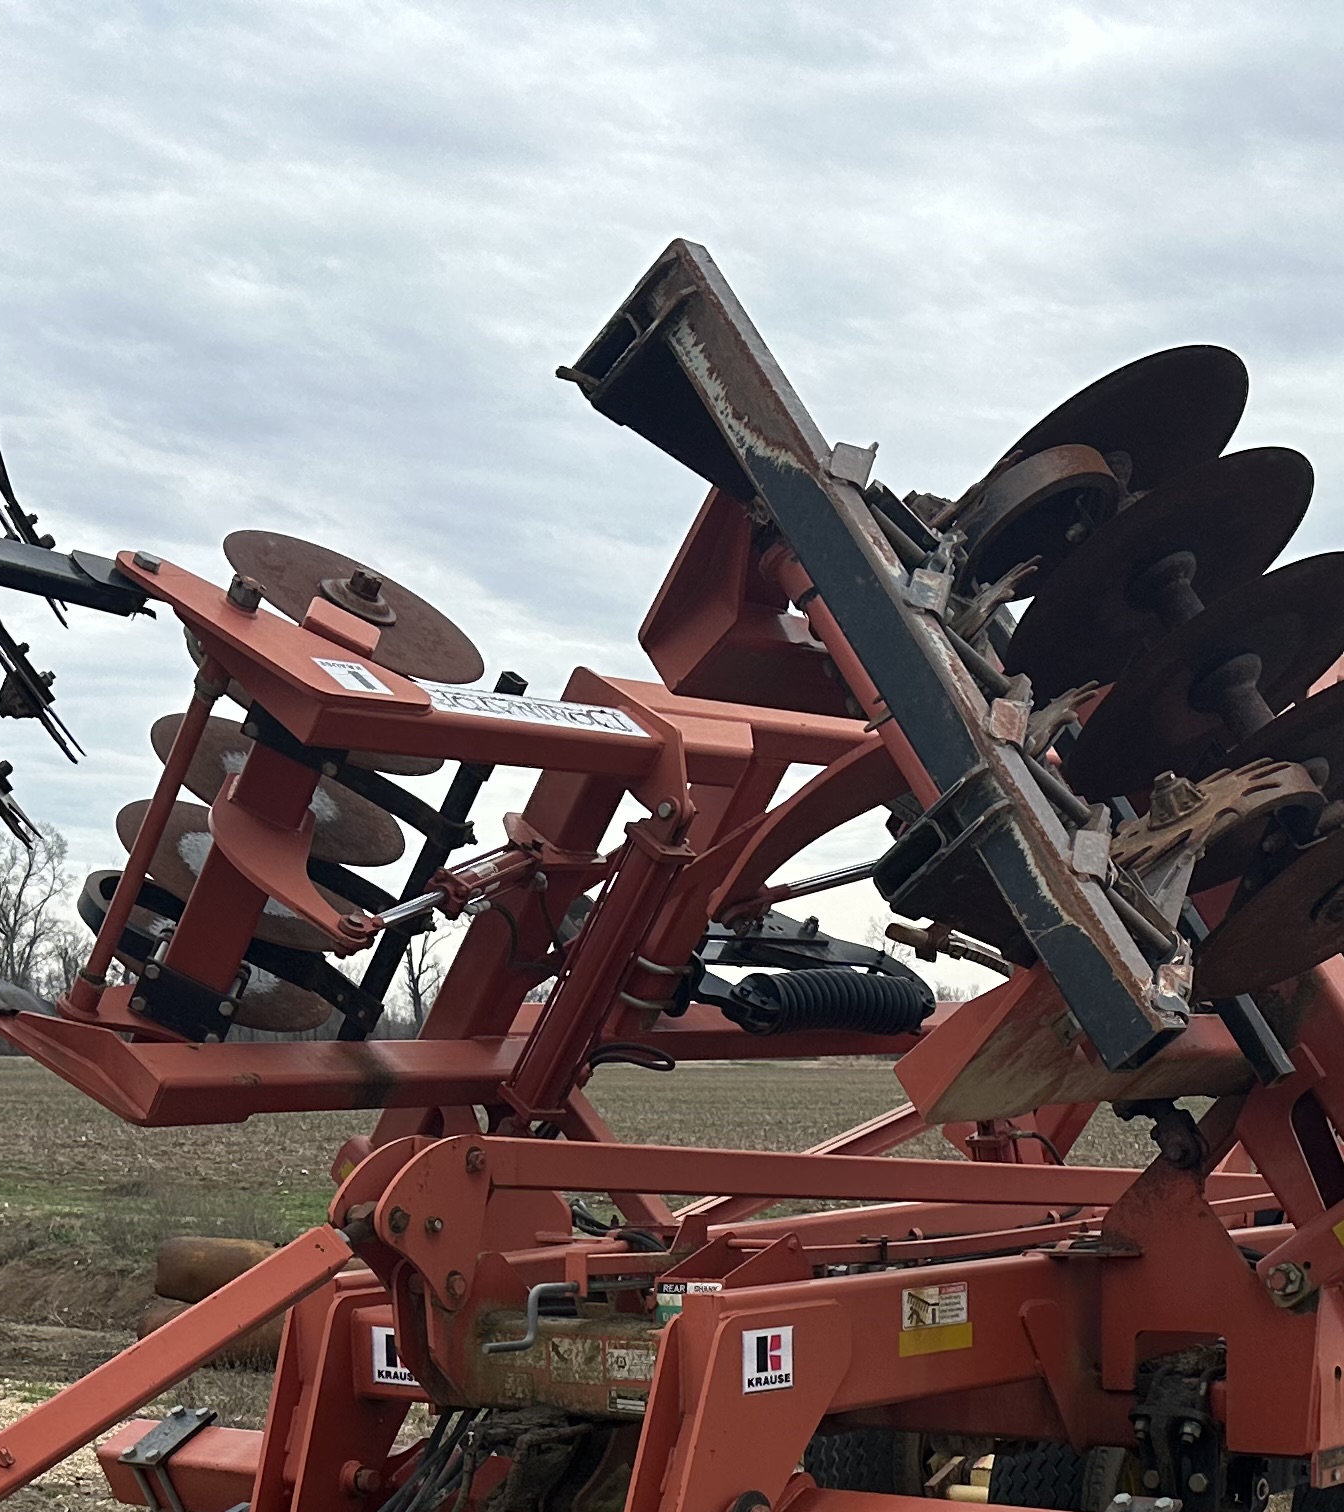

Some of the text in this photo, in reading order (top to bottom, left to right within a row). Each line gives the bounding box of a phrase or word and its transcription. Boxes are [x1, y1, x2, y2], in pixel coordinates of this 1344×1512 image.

[662, 1284, 686, 1293] REAR
[377, 1369, 416, 1382] KRAUS
[747, 1373, 791, 1389] KRAUSE
